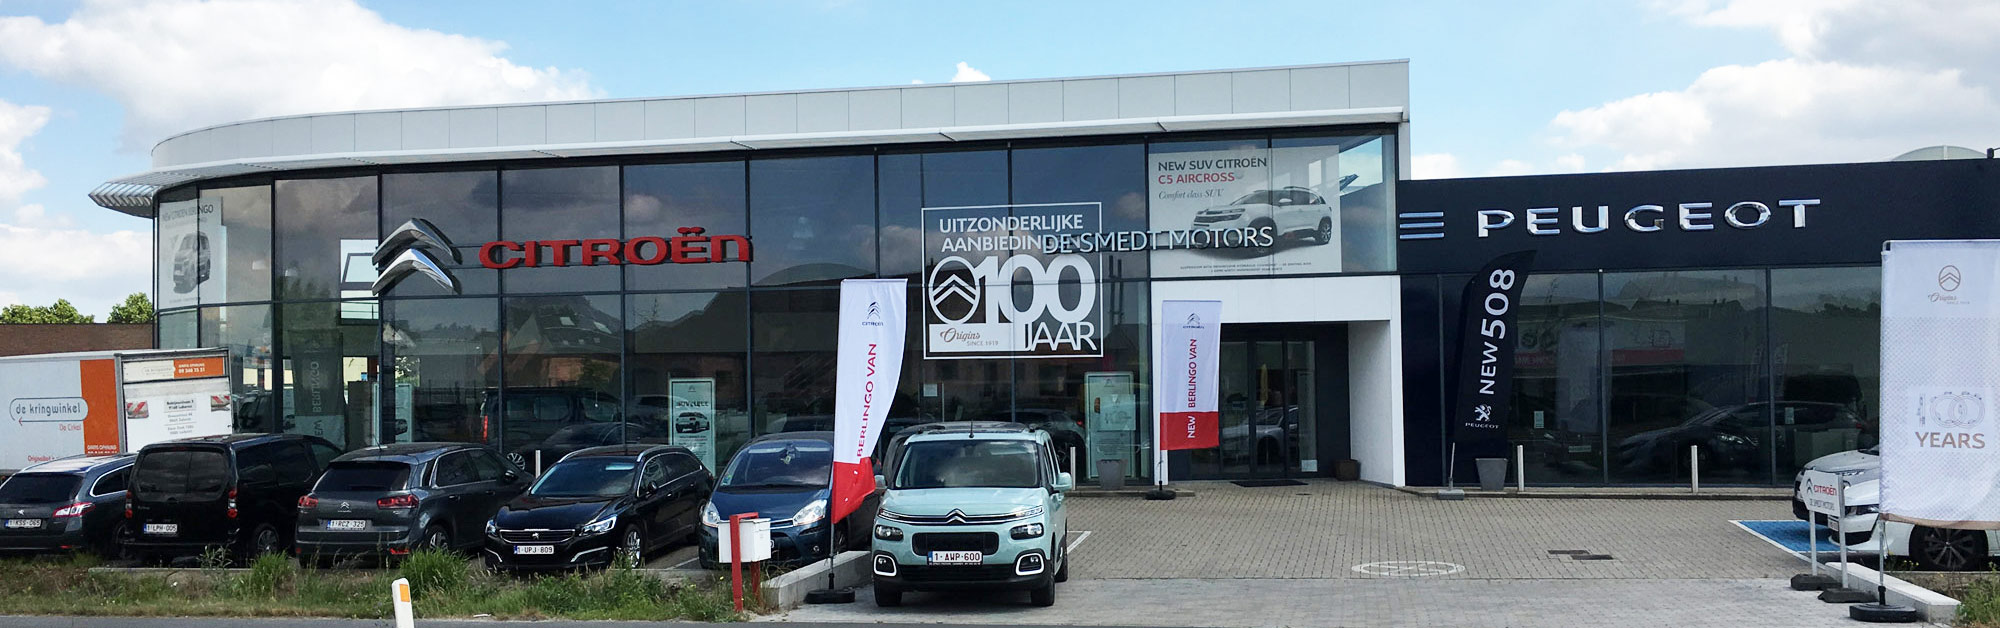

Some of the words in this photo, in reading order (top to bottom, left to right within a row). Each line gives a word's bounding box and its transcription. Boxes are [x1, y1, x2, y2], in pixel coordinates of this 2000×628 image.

[1158, 161, 1187, 172] NEW
[1189, 159, 1213, 170] SUV
[1158, 174, 1173, 185] C5
[1176, 172, 1235, 184] AIRCROSS
[1158, 189, 1186, 201] Comfort
[1204, 188, 1225, 198] SUV
[939, 214, 1084, 233] UITZONDERLIJKE
[1478, 199, 1820, 238] PEUGEOT
[478, 226, 753, 269] CITROËN
[1043, 234, 1073, 254] DE
[1080, 230, 1163, 253] SMEDT
[1169, 226, 1274, 250] MOTORS
[973, 254, 1097, 324] 100
[1481, 269, 1516, 340] 508
[940, 327, 981, 342] Origins
[1025, 321, 1098, 352] JAAR
[1189, 338, 1197, 360] VAN
[1479, 341, 1499, 395] NEW
[1188, 361, 1197, 408] BERLINGO
[16, 403, 26, 415] de
[29, 402, 81, 417] kringwinkel
[857, 380, 874, 458] BERLINGO
[866, 343, 877, 377] VAN
[1187, 415, 1196, 439] NEW
[1914, 431, 1986, 449] YEARS
